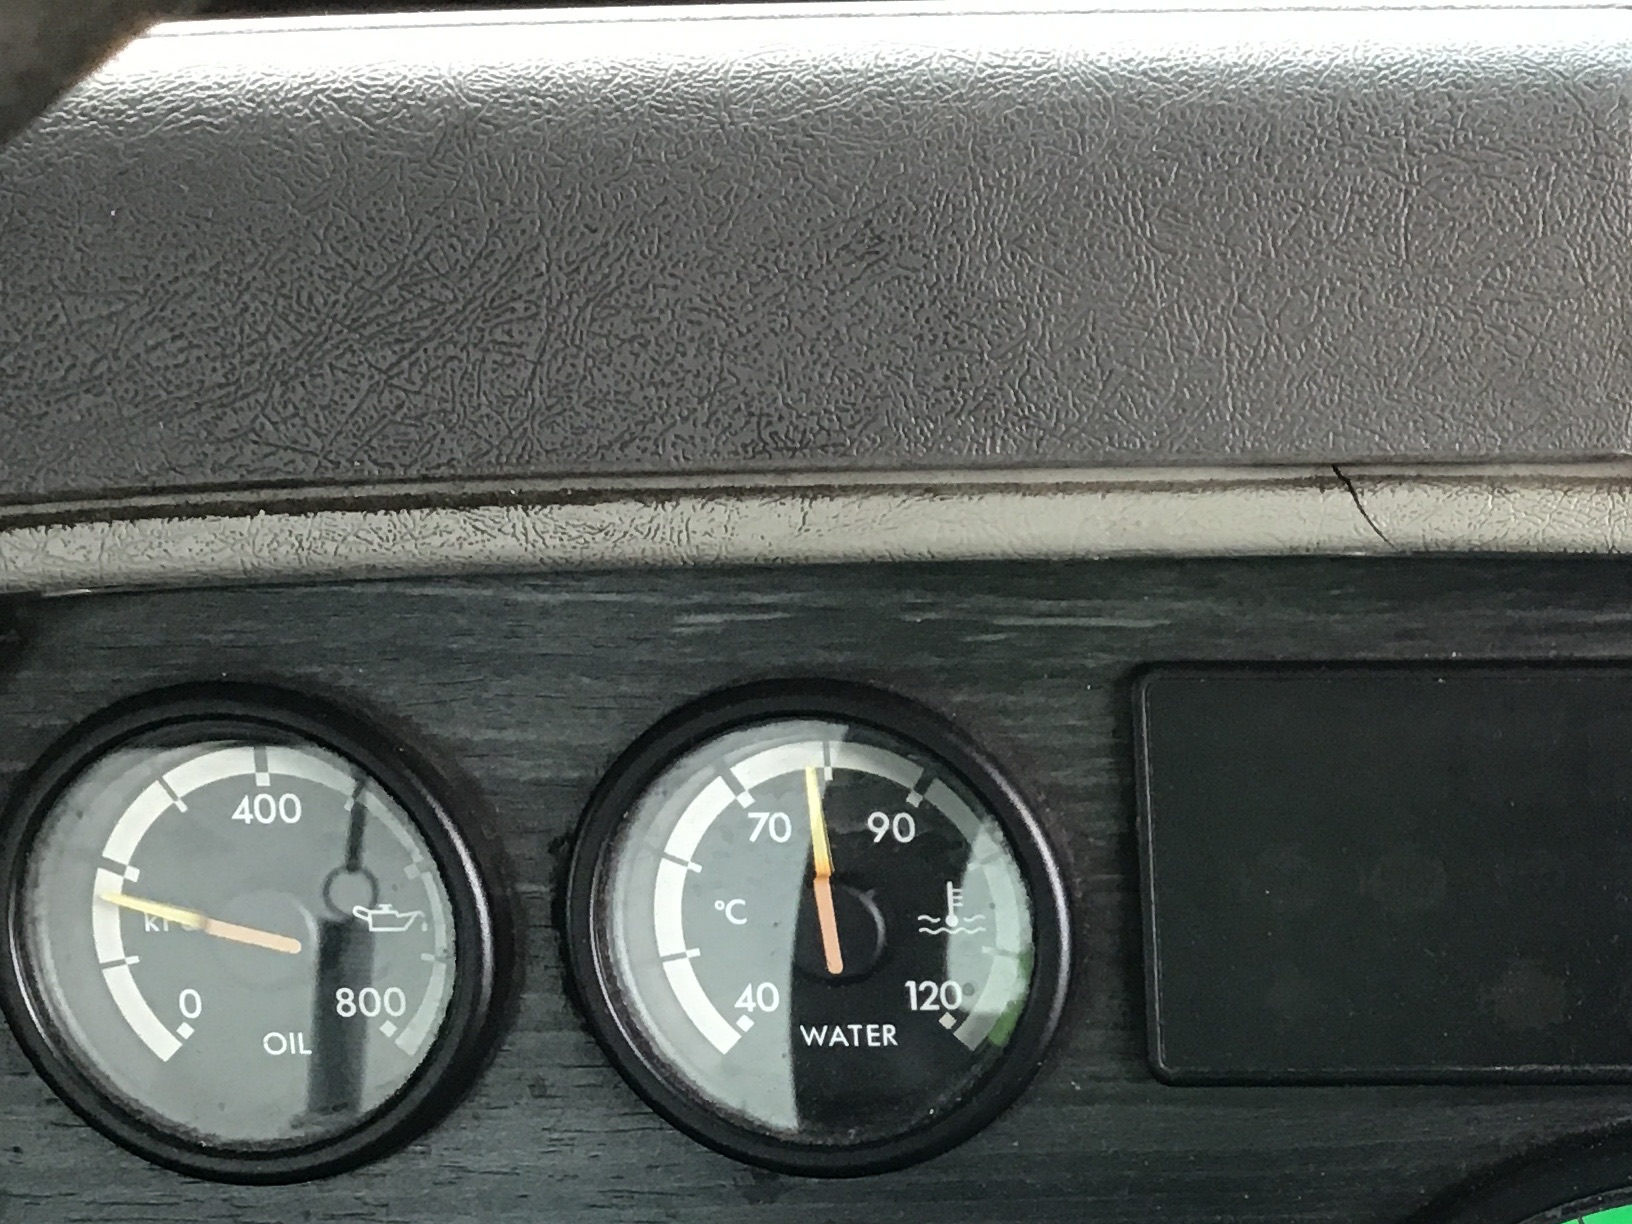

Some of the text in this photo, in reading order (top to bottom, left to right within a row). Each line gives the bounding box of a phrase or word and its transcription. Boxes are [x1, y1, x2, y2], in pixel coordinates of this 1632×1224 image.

[231, 794, 302, 825] 400
[747, 812, 792, 843] 70
[867, 812, 916, 844] 90
[715, 898, 748, 926] °C
[179, 988, 202, 1018] 0
[335, 987, 406, 1018] 800
[734, 982, 780, 1013] 40
[905, 980, 962, 1012] 120
[263, 1033, 312, 1055] OIL
[800, 1024, 899, 1048] WATER
